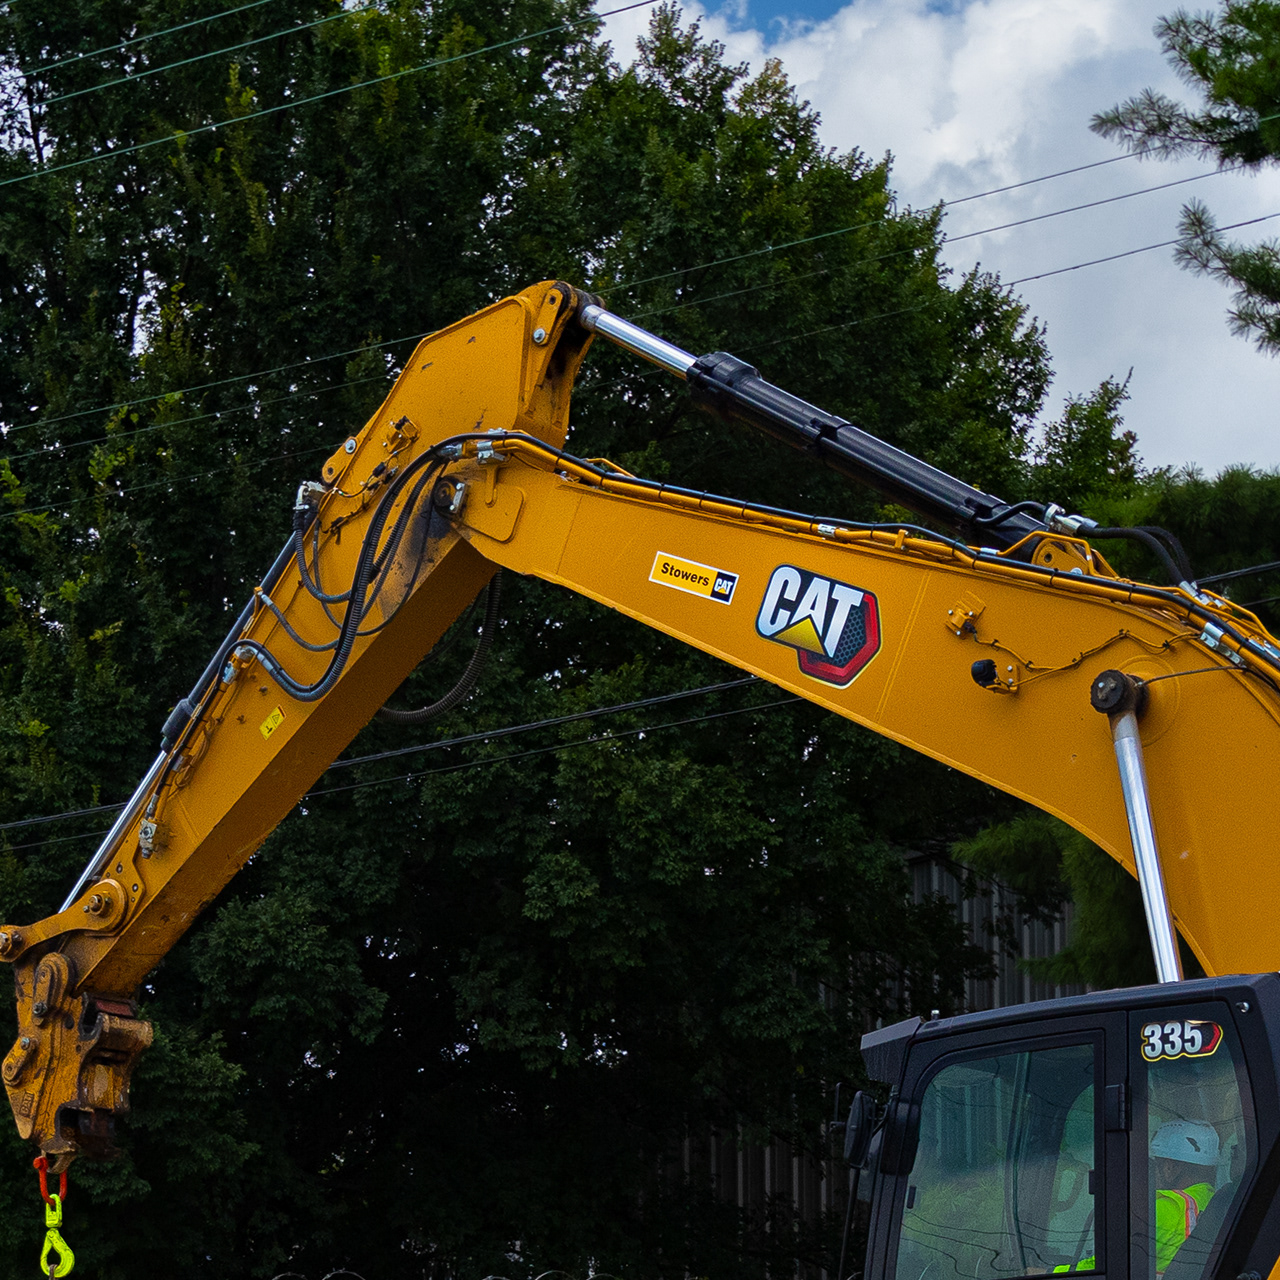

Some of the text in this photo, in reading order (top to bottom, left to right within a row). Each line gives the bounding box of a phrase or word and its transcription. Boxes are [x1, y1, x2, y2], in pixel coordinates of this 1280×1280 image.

[661, 562, 733, 595] Stowers CAT
[758, 565, 865, 658] CAT
[1144, 1021, 1202, 1058] 335
